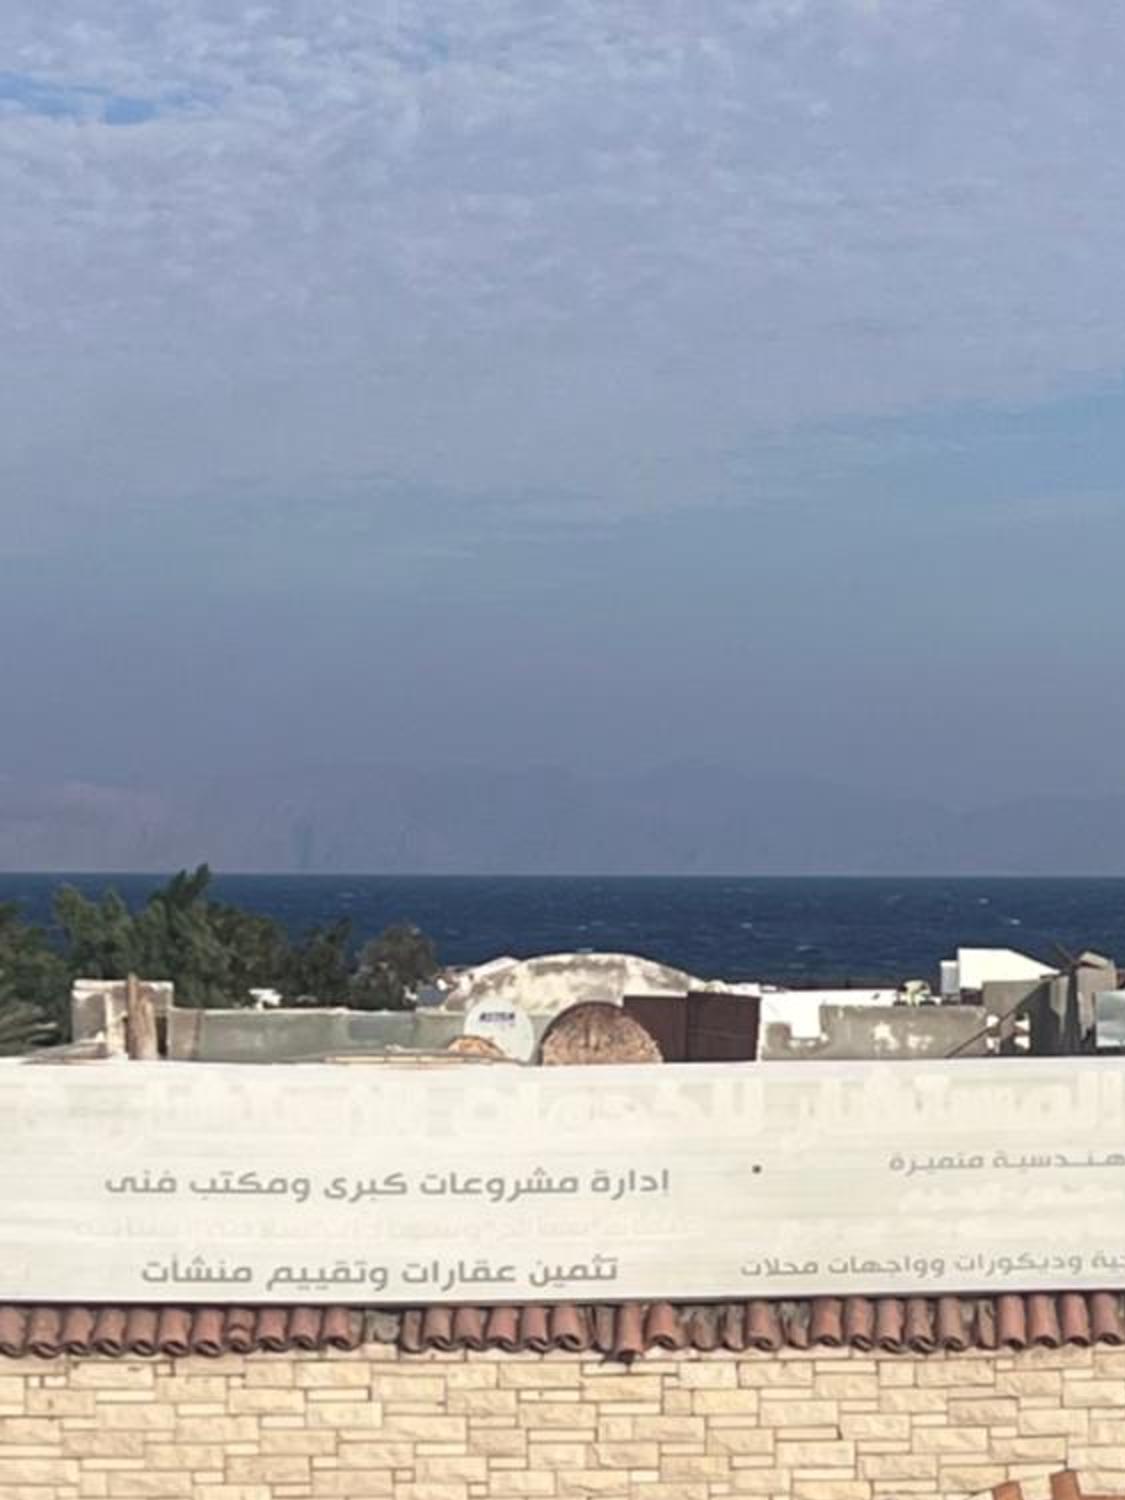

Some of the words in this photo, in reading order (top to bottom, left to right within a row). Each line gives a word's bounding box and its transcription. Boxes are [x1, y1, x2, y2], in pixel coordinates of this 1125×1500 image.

[189, 1171, 311, 1204] ومكتب
[323, 1171, 408, 1204] كبرى
[420, 1165, 577, 1204] مشروعات
[265, 1260, 389, 1292] وتقييم
[400, 1259, 517, 1292] عقارات
[528, 1253, 619, 1290] تثمين
[740, 1257, 818, 1278] محلات
